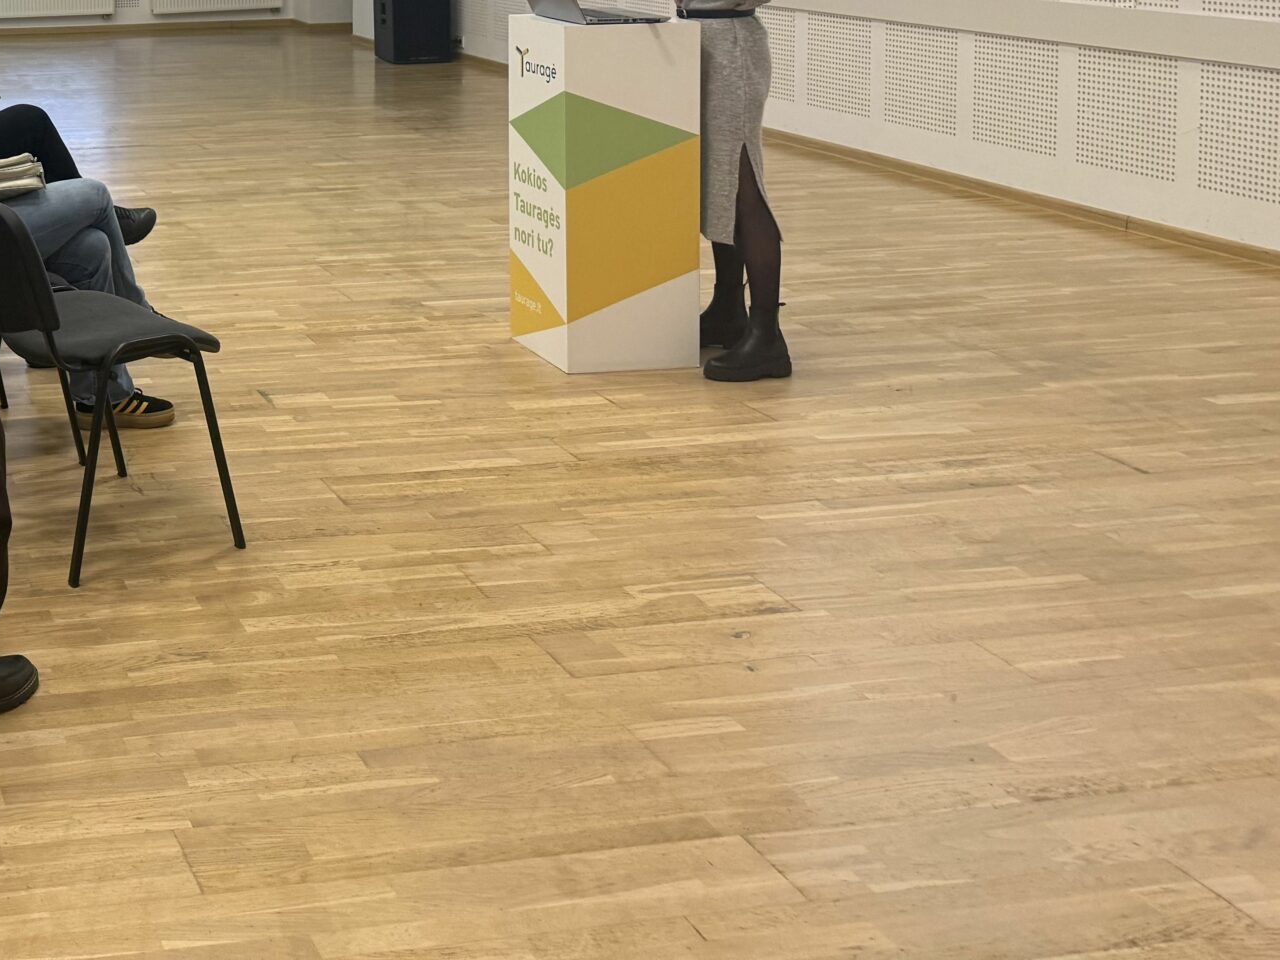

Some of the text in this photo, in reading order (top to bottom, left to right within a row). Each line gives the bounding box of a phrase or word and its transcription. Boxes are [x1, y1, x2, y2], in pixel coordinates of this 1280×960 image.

[513, 161, 548, 193] Kokios
[513, 191, 561, 231] Tauragės
[514, 226, 554, 258] nori tu?
